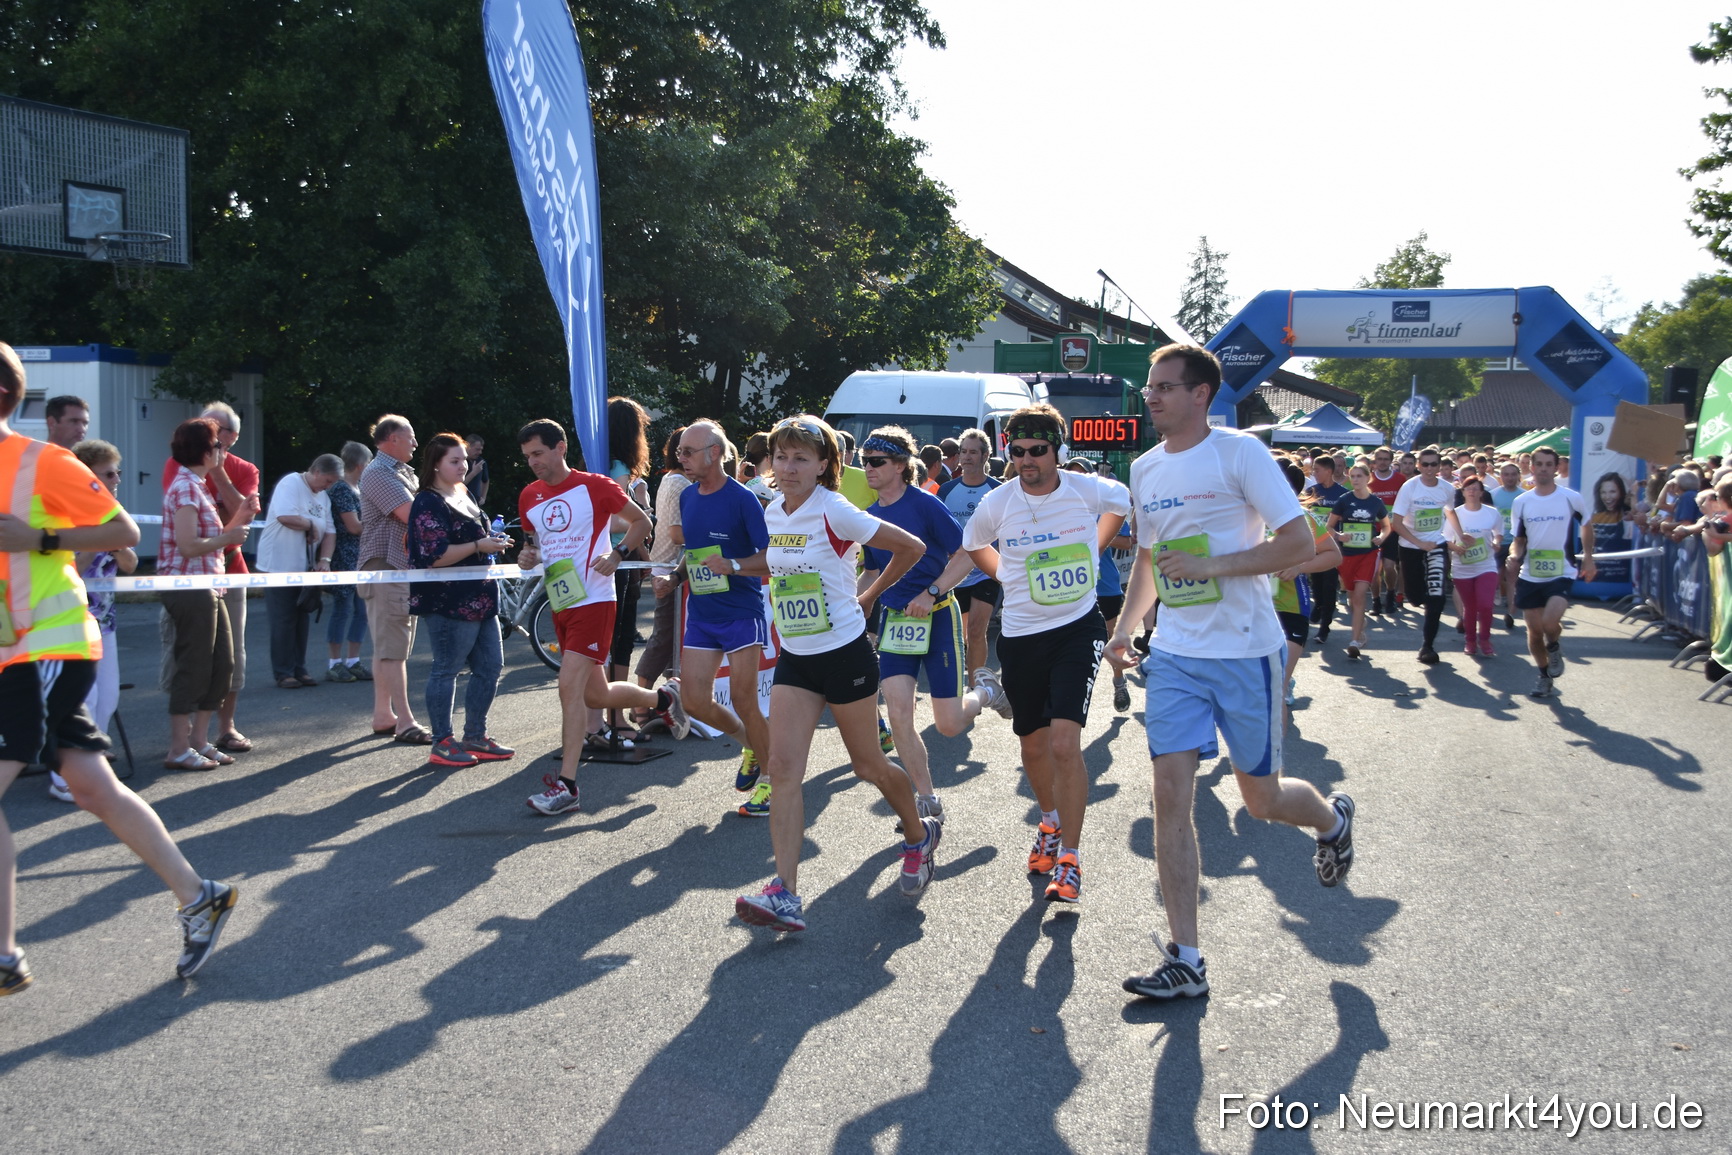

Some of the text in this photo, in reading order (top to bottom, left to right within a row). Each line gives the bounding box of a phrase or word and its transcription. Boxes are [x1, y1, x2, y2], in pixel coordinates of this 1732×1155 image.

[1399, 307, 1428, 315] Fischer
[1377, 322, 1463, 338] firmenlauf
[1222, 352, 1265, 361] Fischer
[1699, 412, 1730, 444] AOK
[1183, 491, 1216, 500] energie
[1417, 517, 1440, 527] 1312
[1535, 561, 1556, 571] 283
[1036, 566, 1088, 591] 1306
[552, 580, 570, 597] 73
[778, 598, 819, 620] 1020
[889, 625, 926, 641] 1492
